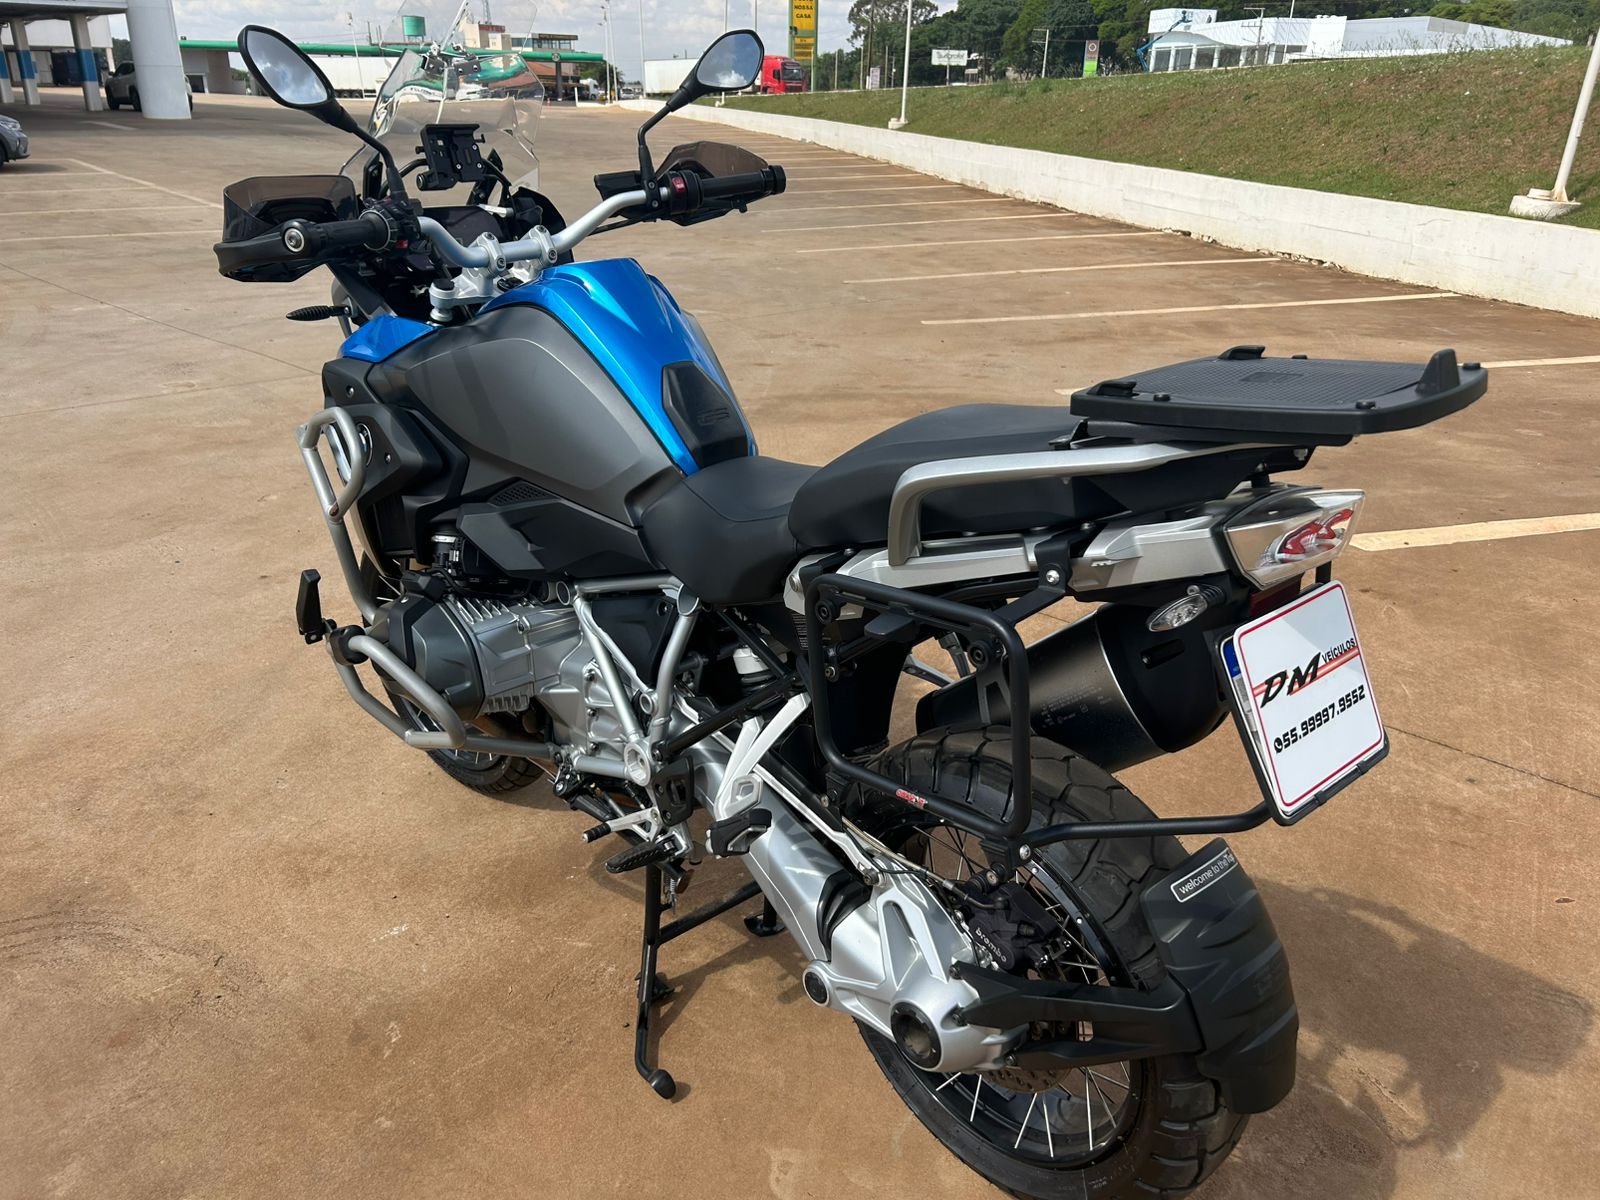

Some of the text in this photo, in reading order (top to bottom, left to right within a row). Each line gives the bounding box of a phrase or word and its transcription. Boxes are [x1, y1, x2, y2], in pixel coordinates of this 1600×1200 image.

[1260, 638, 1356, 708] DM VEÍCULOS
[1282, 684, 1366, 750] 55.99997.9552
[1179, 869, 1214, 894] welcome
[1211, 864, 1220, 874] to
[1217, 859, 1229, 870] the
[976, 927, 1007, 963] brembo
